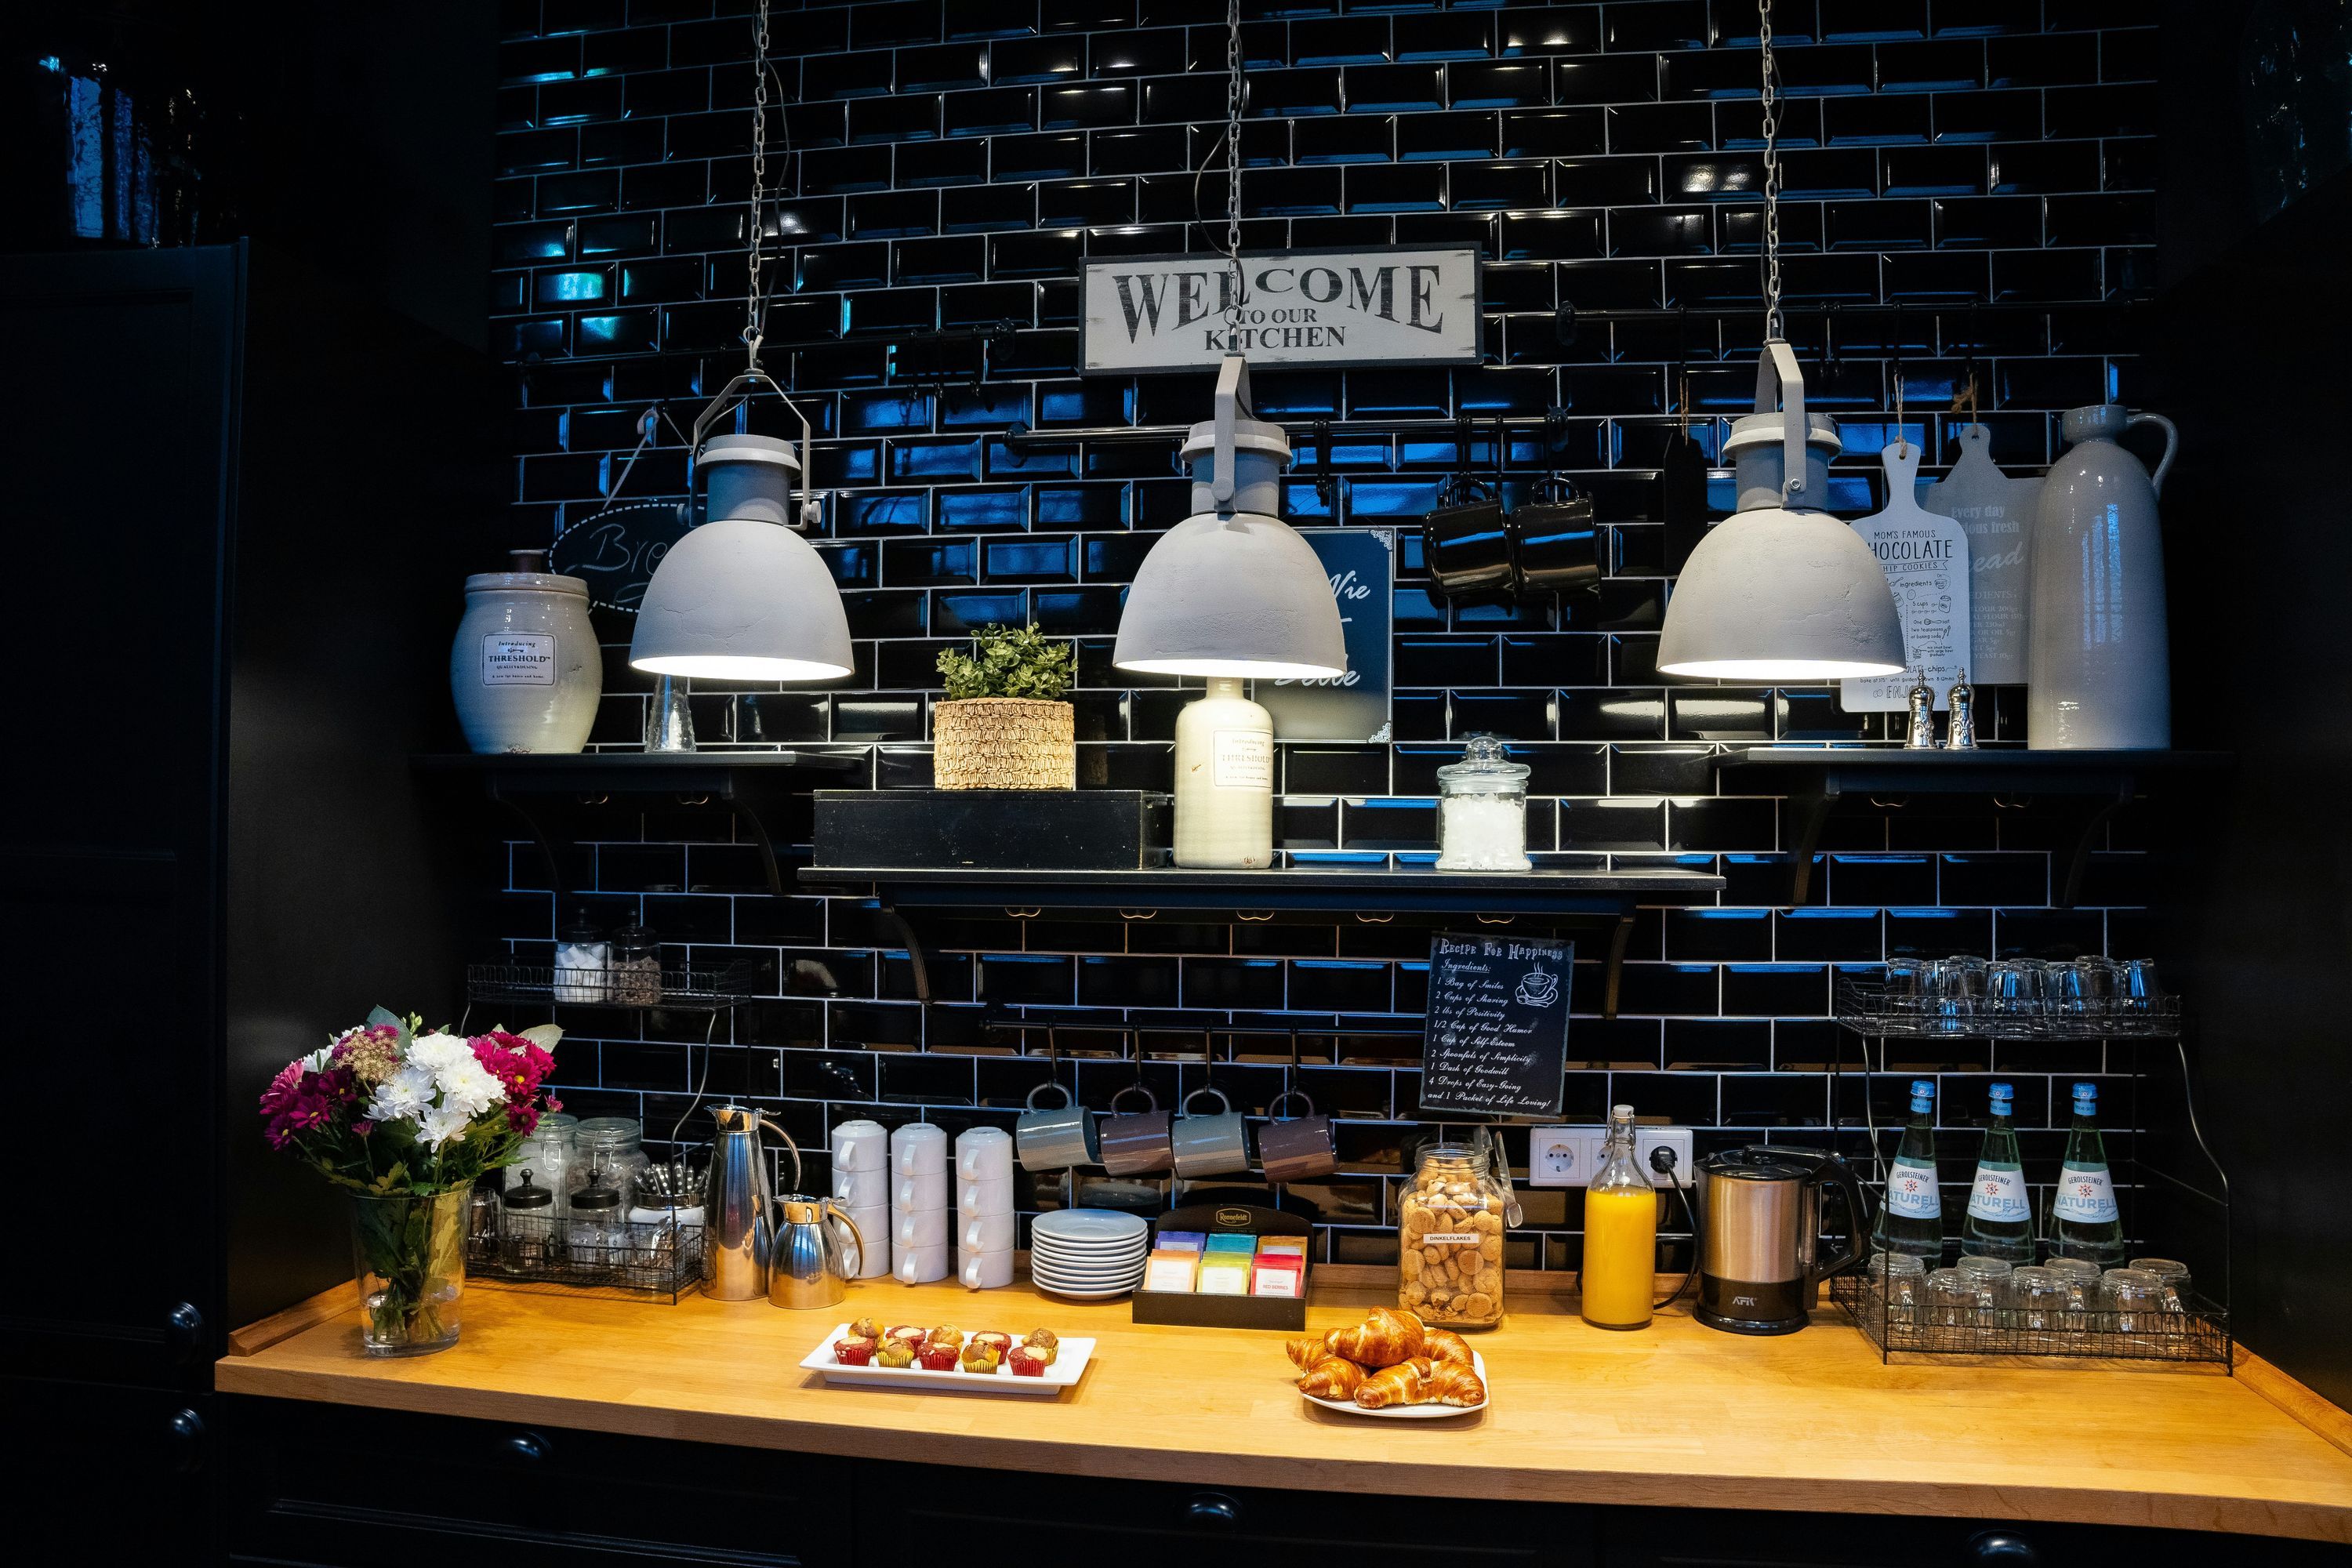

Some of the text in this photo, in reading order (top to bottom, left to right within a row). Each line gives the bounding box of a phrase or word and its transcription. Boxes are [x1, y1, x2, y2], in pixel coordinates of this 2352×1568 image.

[1112, 265, 1443, 344] WELCOME
[1236, 308, 1318, 325] TO OUR
[1203, 326, 1347, 351] KTCHEN
[1874, 529, 1936, 539] MOM'S FAMOUS
[564, 524, 668, 575] Bre
[1867, 539, 1953, 560] HOCOLATE
[1970, 541, 2024, 572] ead
[1903, 561, 1938, 571] COOKIES
[1442, 958, 1491, 973] Ingredients:
[1444, 977, 1465, 989] Bag
[1467, 980, 1478, 990] of
[1479, 979, 1504, 989] Smiles
[1444, 991, 1462, 1003] Cups
[1465, 993, 1475, 1004] of
[1476, 993, 1508, 1007] Sharing
[1434, 1005, 1439, 1014] 2
[1455, 1007, 1466, 1018] of
[1466, 1007, 1505, 1021] Positivity
[1433, 1020, 1533, 1034] 1/2 Cup of Good Humor
[1441, 1034, 1457, 1045] Cup
[1459, 1036, 1470, 1047] of
[1470, 1036, 1515, 1047] Self-Esteem
[1439, 1048, 1476, 1061] Spoonfuls
[1479, 1052, 1490, 1062] of
[1490, 1051, 1532, 1064] Simplicity
[1439, 1062, 1461, 1072] Dash
[1463, 1065, 1474, 1075] of
[1475, 1064, 1510, 1075] Goodwill
[1428, 1076, 1522, 1093] 4 Drops of Easy-Going
[1446, 1091, 1450, 1100] 1
[1455, 1091, 1485, 1102] Packet
[1485, 1094, 1496, 1105] of
[1496, 1094, 1514, 1106] Life
[1517, 1096, 1552, 1109] Loving!
[1896, 1171, 1929, 1183] GEROLSTEINER
[1978, 1174, 2011, 1185] GEROLSTEINER
[2068, 1176, 2103, 1186] GEROLSTEINER
[1889, 1191, 1939, 1206] ATURELL
[1970, 1194, 2025, 1209] ATURELL
[2056, 1195, 2117, 1209] NATURELL
[1219, 1213, 1247, 1222] Ronnefeldt
[1732, 1296, 1755, 1306] AFK
